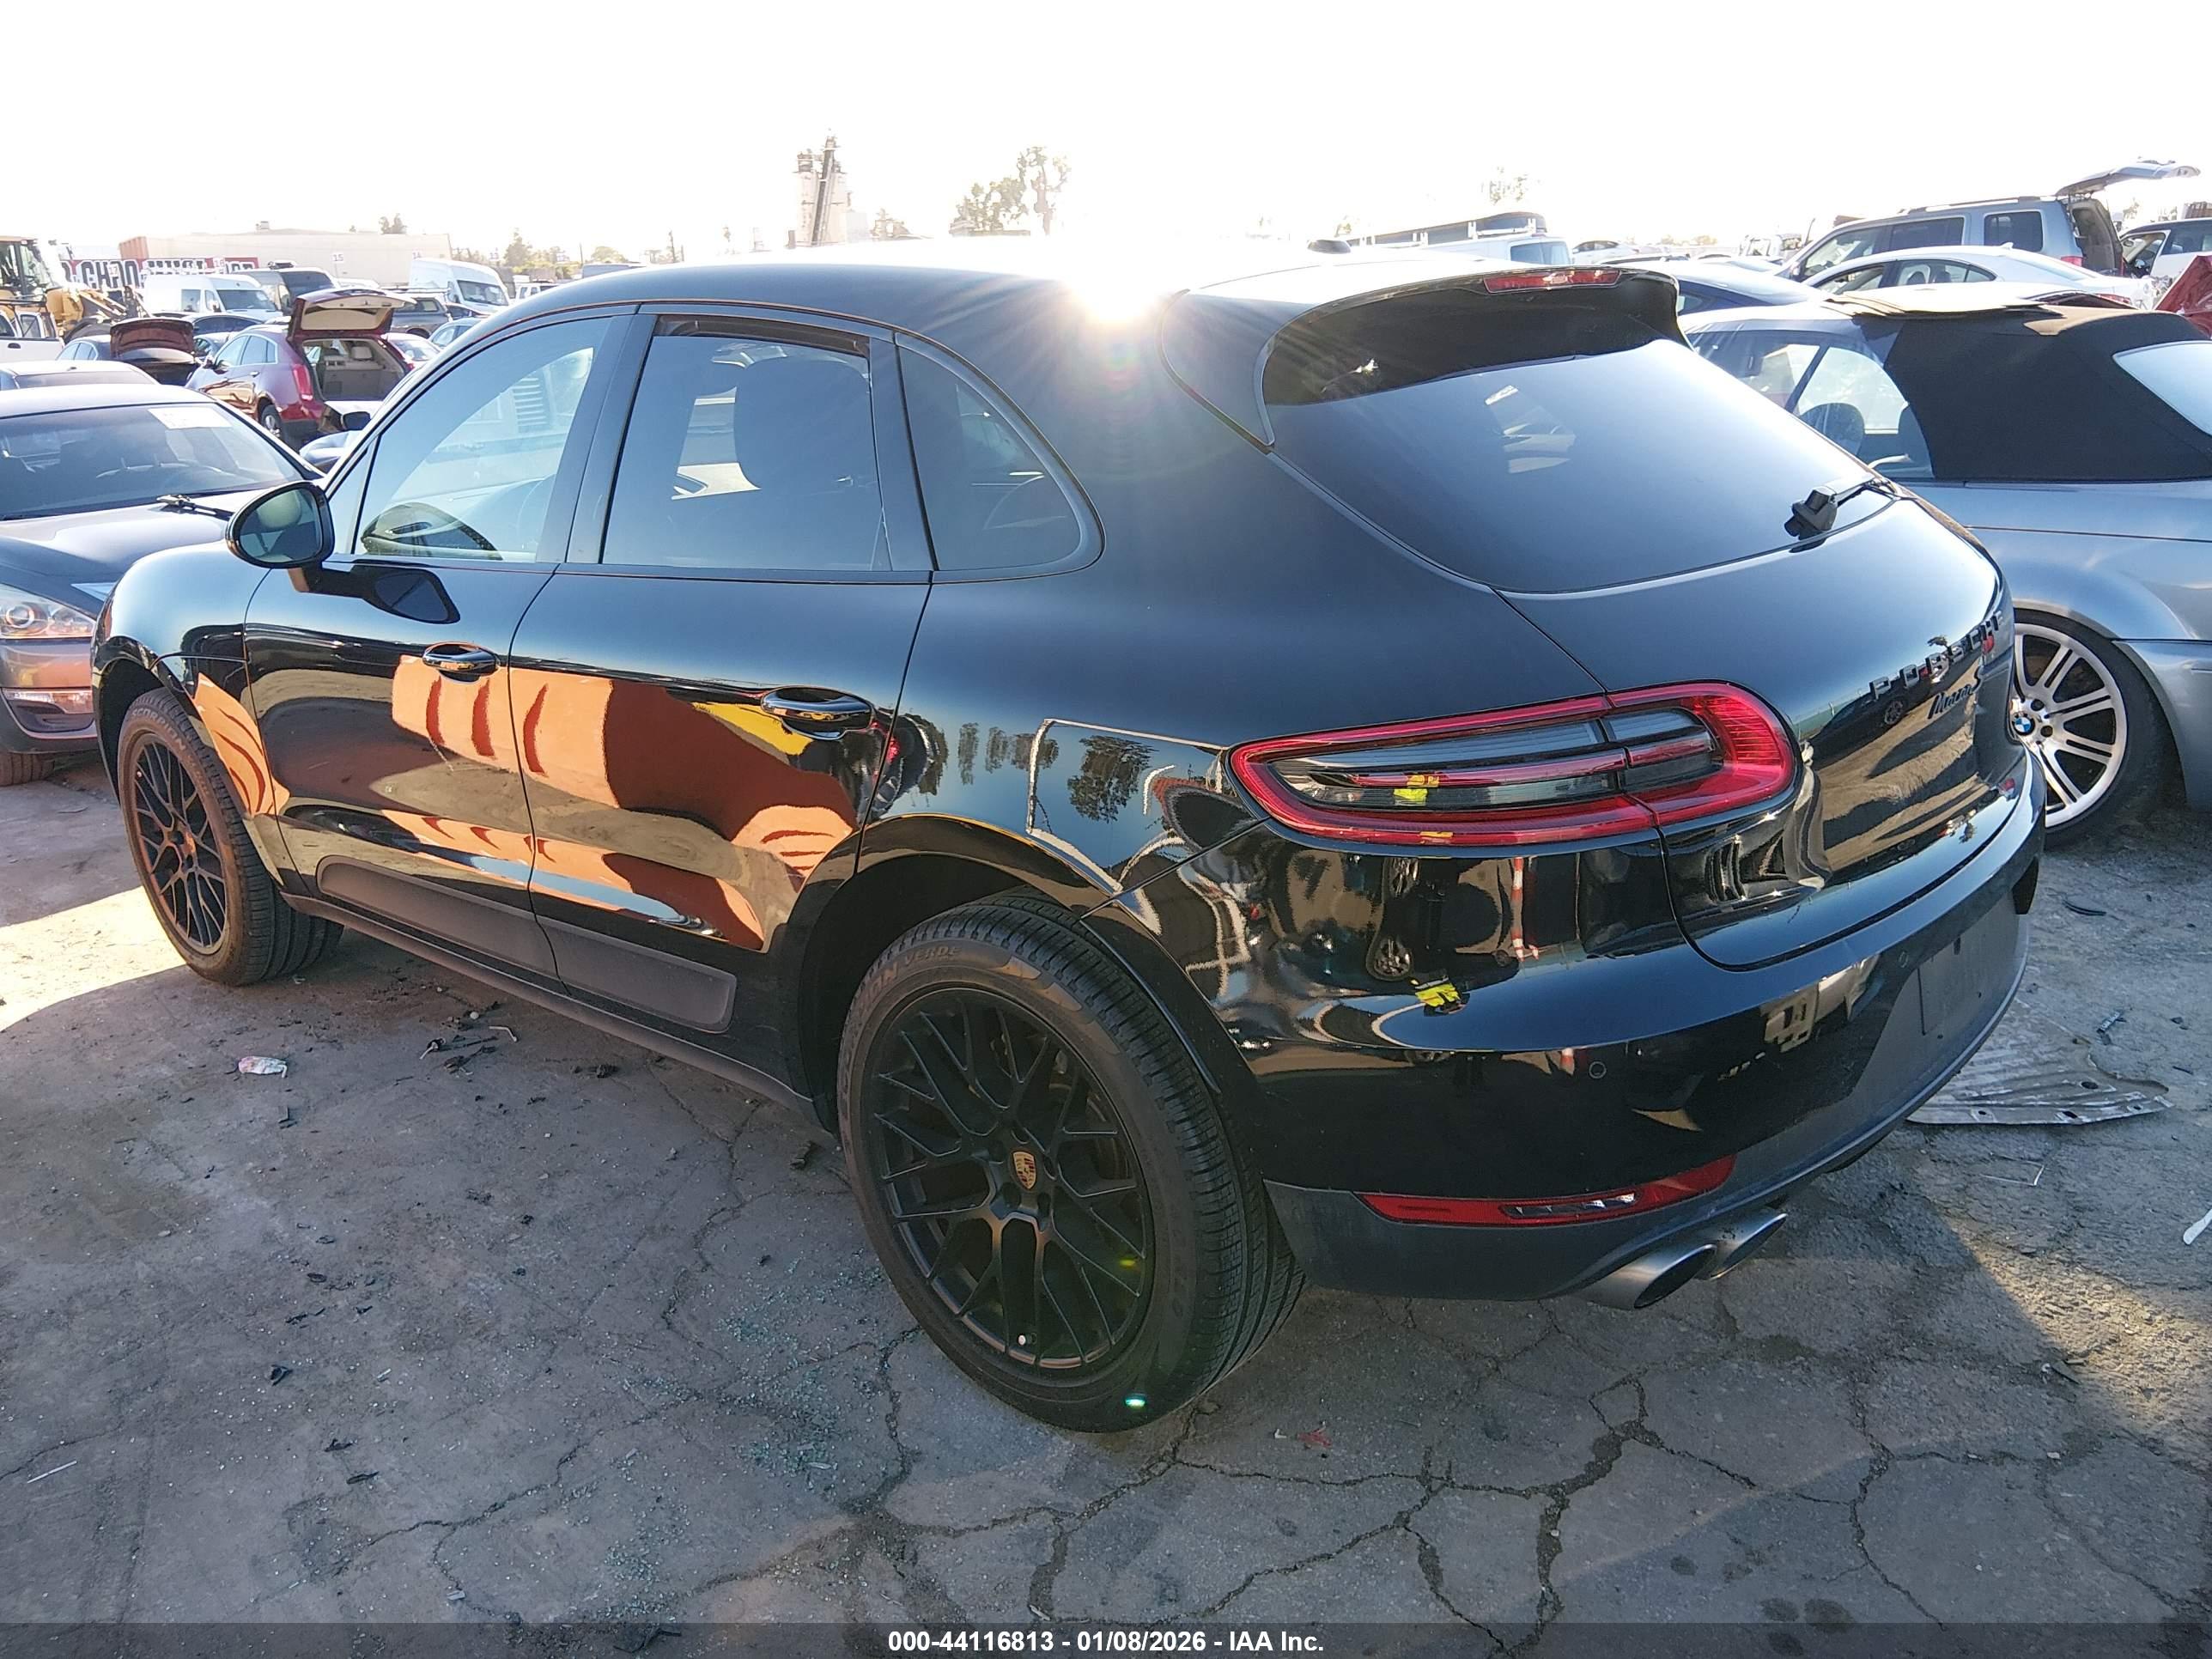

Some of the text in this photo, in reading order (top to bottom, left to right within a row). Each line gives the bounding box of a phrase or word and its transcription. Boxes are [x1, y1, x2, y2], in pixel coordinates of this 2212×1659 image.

[1927, 684, 1974, 720] Macan
[131, 708, 186, 750] SCORPION
[904, 944, 963, 965] VERDE
